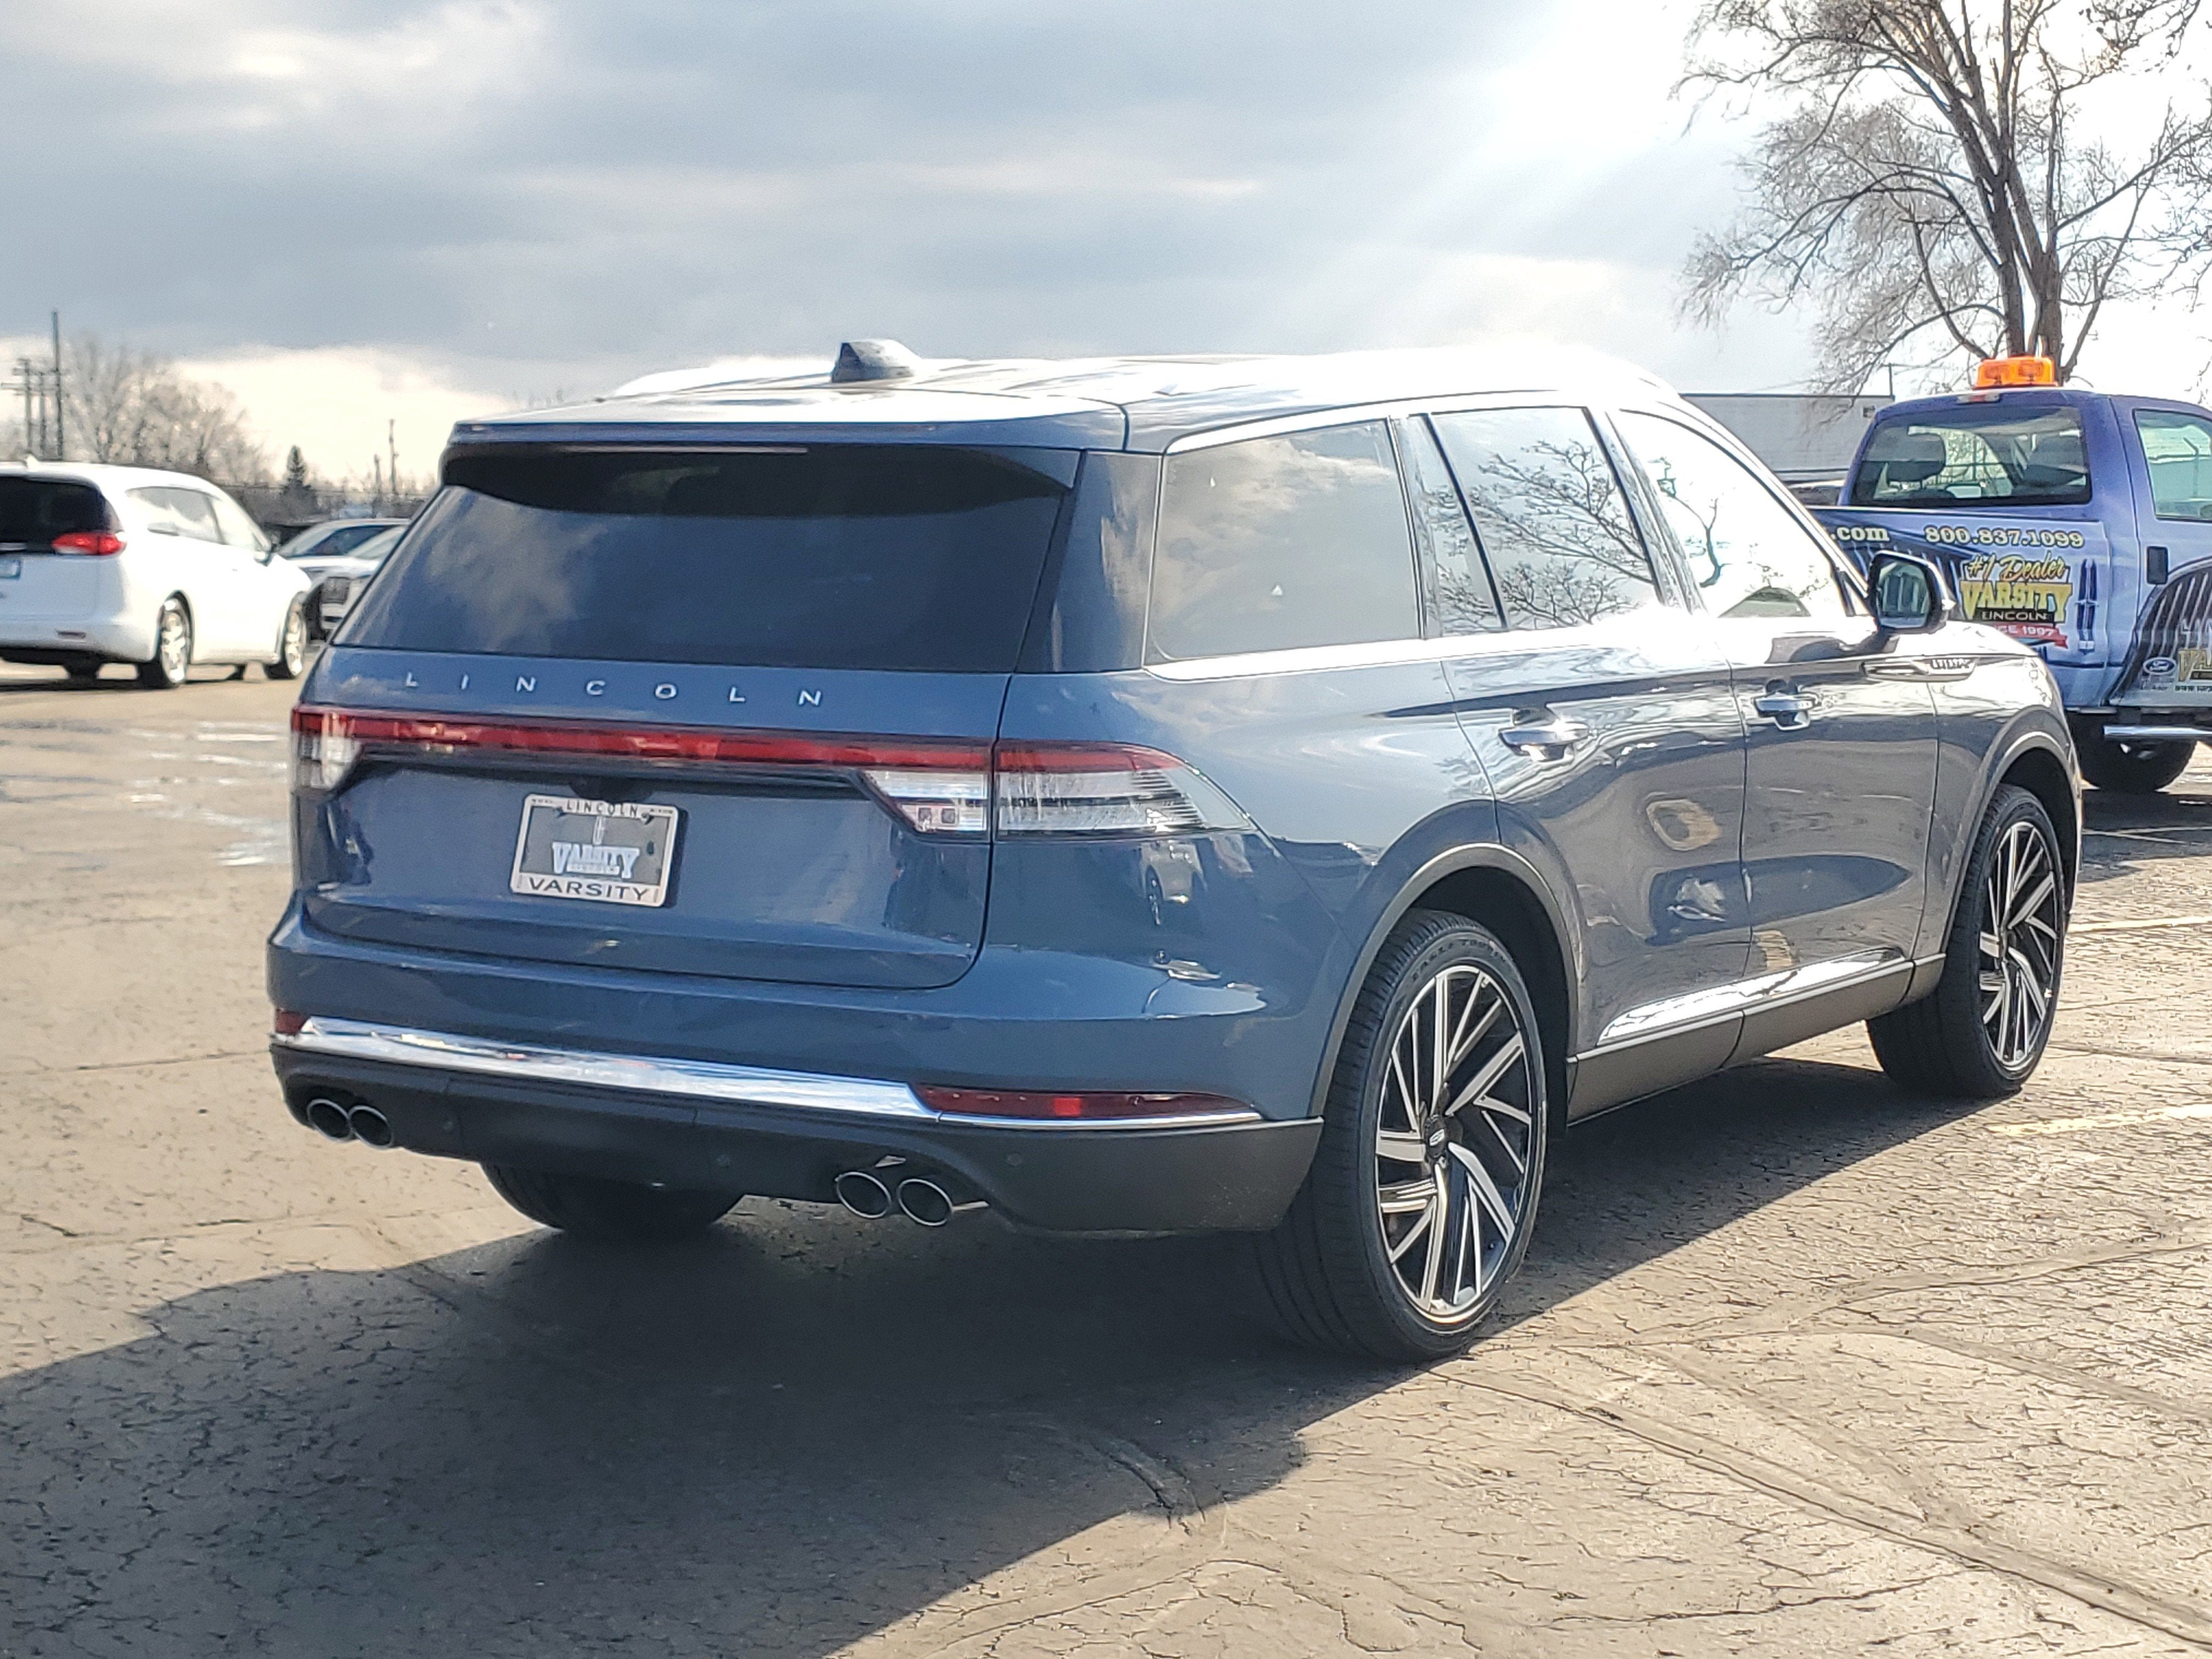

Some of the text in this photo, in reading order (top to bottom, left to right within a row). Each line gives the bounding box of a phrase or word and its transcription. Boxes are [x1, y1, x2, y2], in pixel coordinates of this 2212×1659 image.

[1924, 525, 2084, 547] 800.837.1099
[1968, 550, 2066, 582] #1 Dealer
[1960, 580, 2073, 623] VARSITY
[1981, 611, 2047, 621] LINCOLN
[405, 671, 822, 707] LINCOLN
[566, 799, 639, 817] LINCOLN
[528, 877, 649, 901] VARSITY
